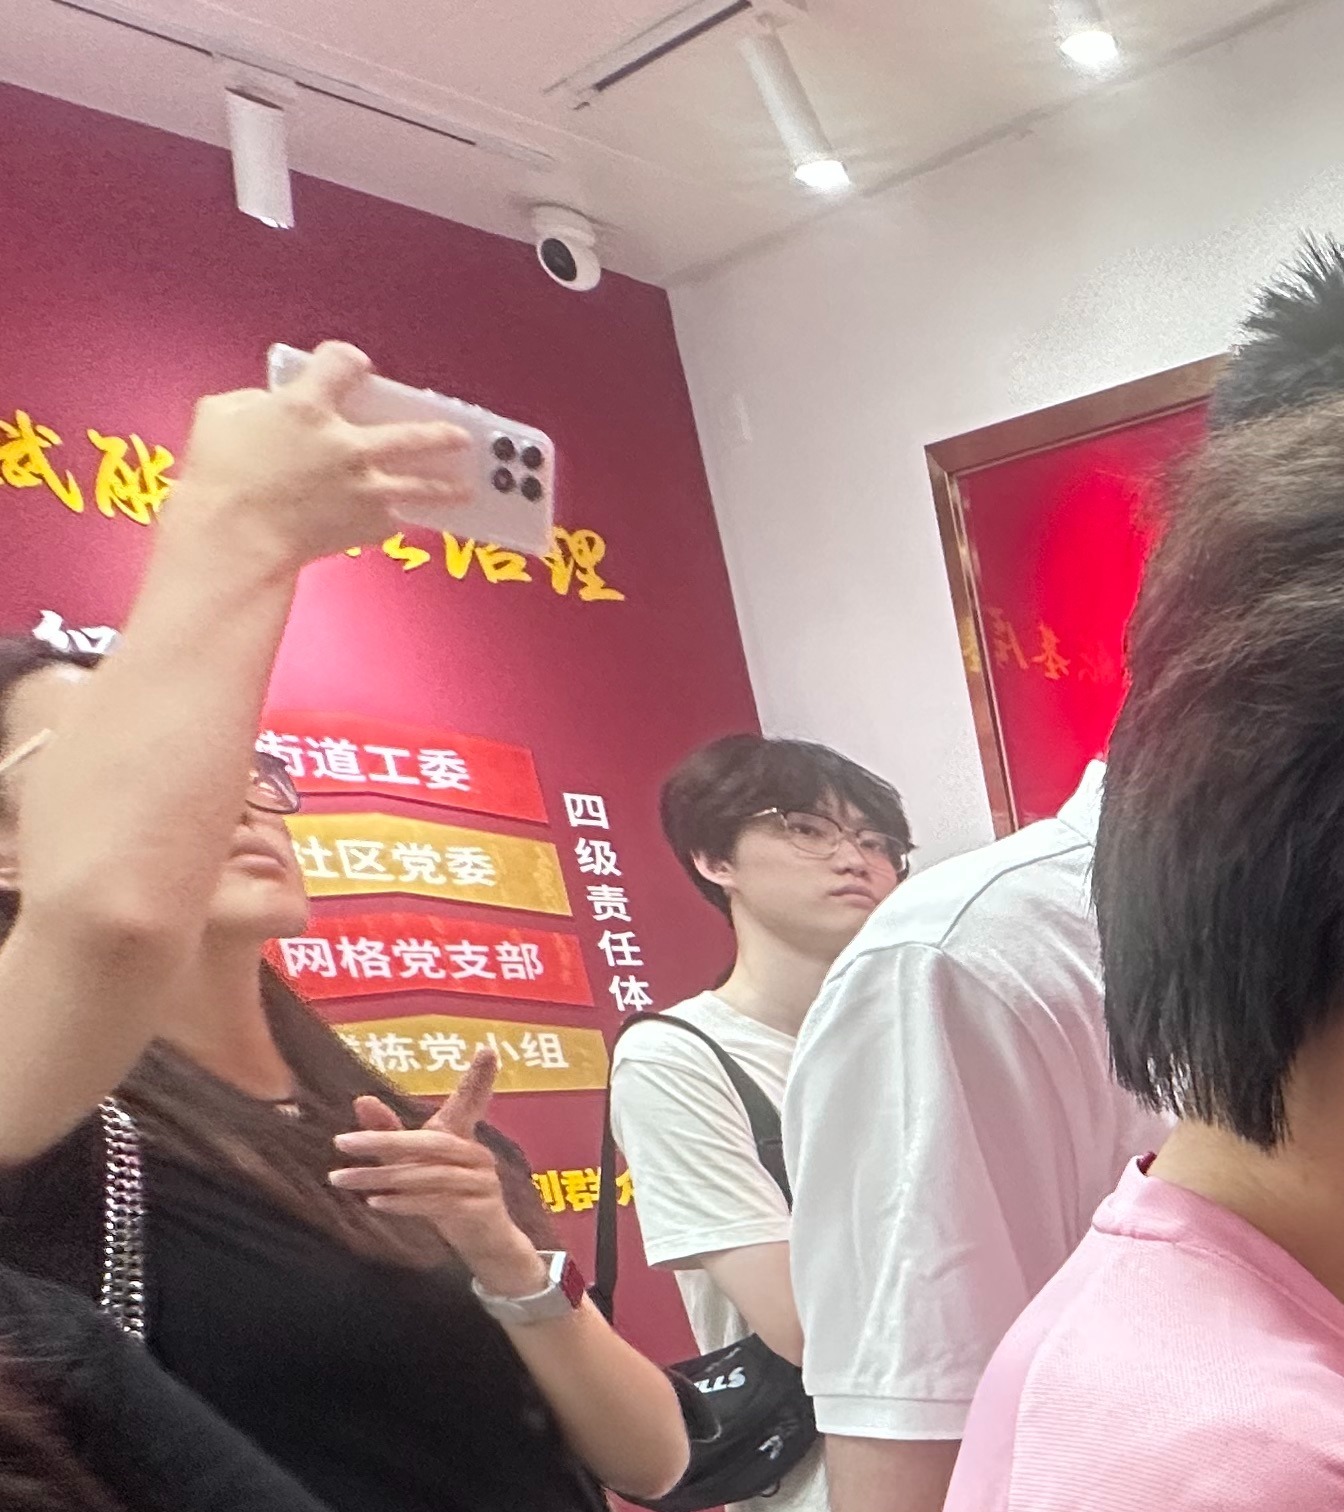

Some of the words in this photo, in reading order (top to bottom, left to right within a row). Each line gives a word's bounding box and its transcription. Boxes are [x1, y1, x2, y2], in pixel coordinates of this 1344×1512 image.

[278, 935, 545, 983] 网格党支部
[562, 791, 655, 1013] 四级责任体
